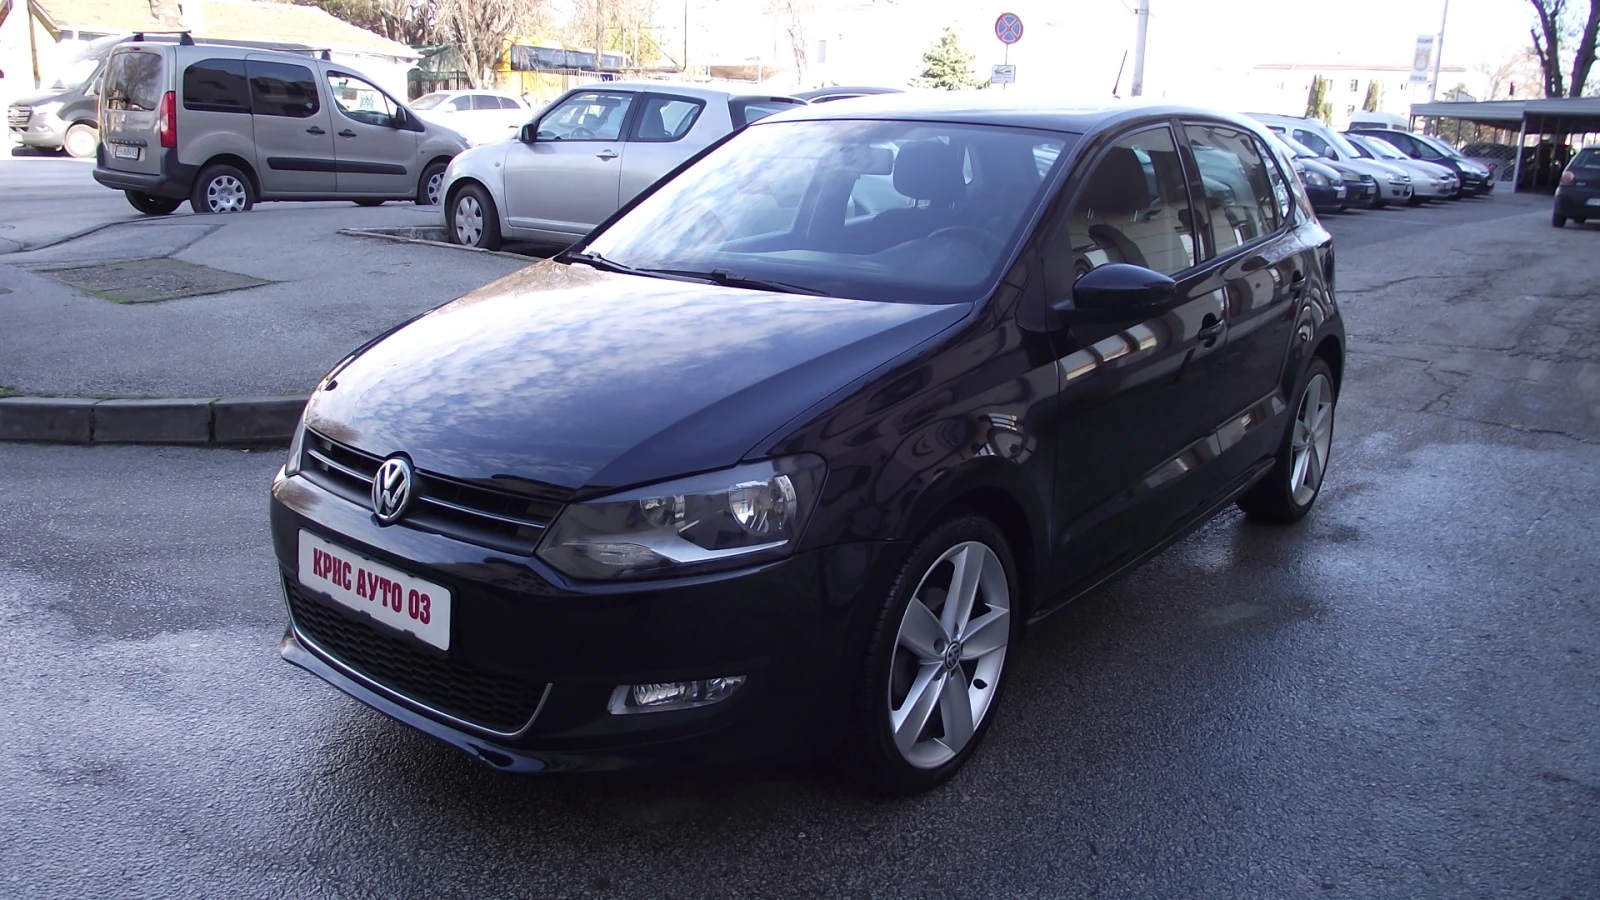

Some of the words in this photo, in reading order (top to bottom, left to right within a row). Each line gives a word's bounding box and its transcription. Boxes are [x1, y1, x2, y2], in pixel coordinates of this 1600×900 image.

[313, 547, 352, 591] КРИС
[356, 568, 403, 613] АУТО
[408, 588, 431, 625] 03
